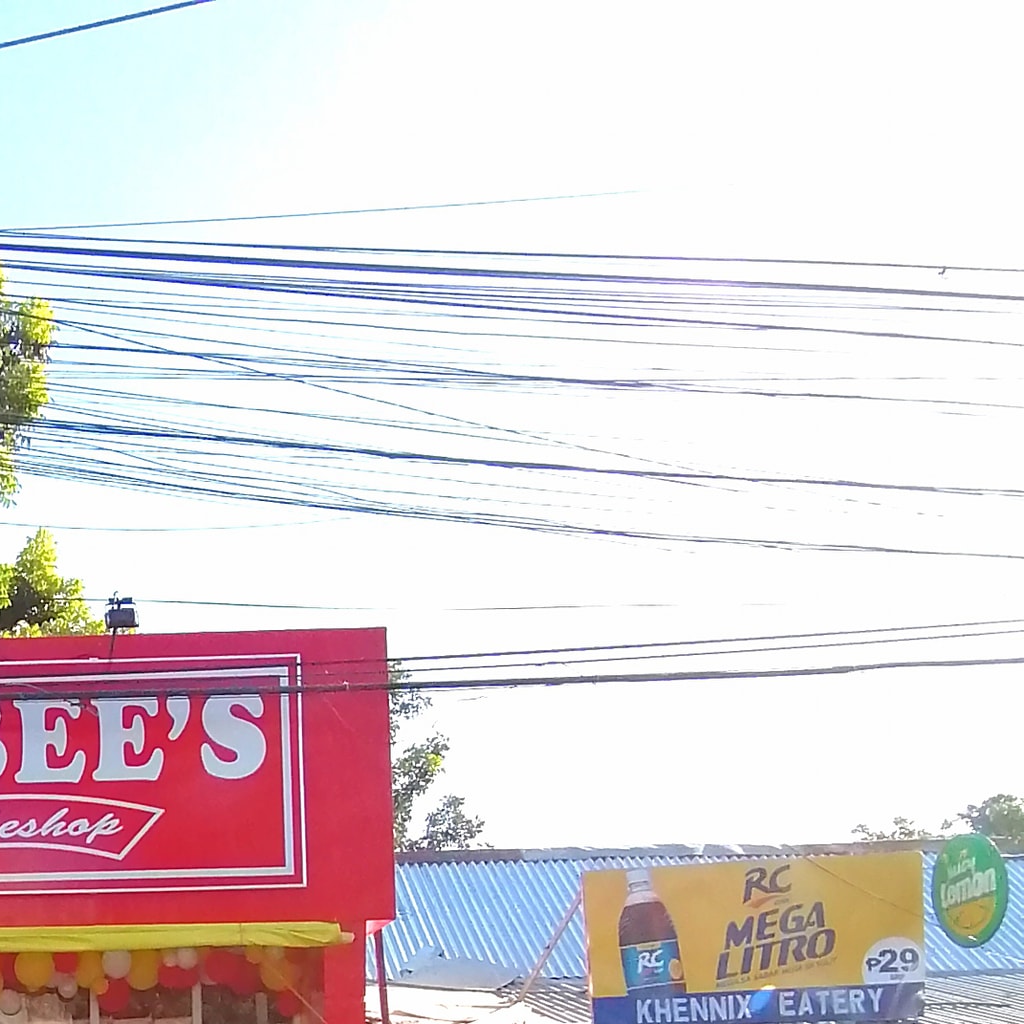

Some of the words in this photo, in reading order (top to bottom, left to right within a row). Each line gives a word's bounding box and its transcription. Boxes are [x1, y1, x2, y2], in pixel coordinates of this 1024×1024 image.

[742, 864, 792, 904] RC
[724, 902, 825, 950] MEGA
[637, 950, 664, 974] RC
[716, 929, 836, 980] LITRO
[637, 996, 752, 1024] KHENNIX
[779, 987, 884, 1016] EATERY
